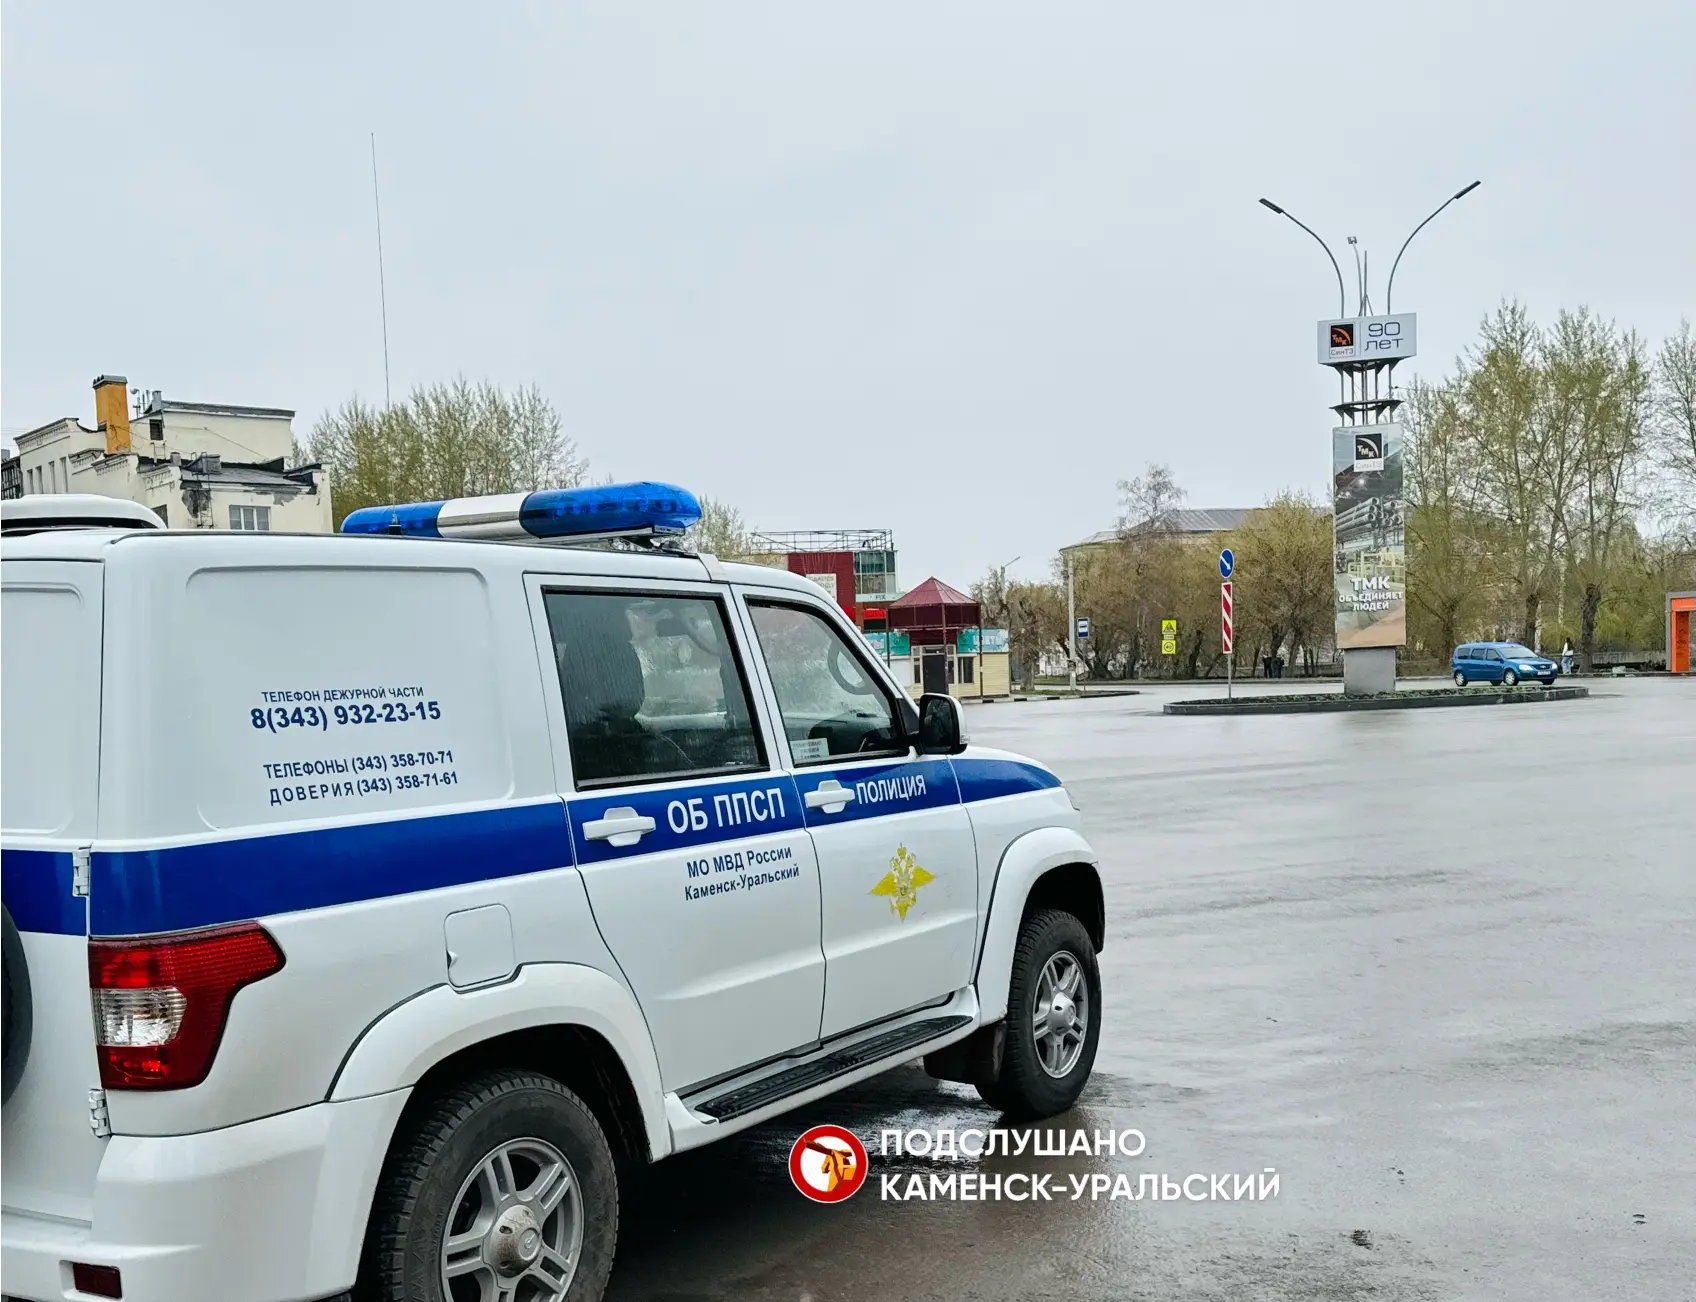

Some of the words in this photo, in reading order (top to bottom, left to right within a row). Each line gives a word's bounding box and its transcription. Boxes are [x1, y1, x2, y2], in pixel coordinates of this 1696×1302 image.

[1368, 322, 1400, 337] 90
[1332, 334, 1347, 345] ТМК
[1365, 338, 1404, 351] лет
[1331, 348, 1353, 356] СинТЗ
[1357, 445, 1375, 458] ТМК
[1351, 576, 1390, 591] ТМК
[1338, 591, 1404, 603] ОБЪЕДИНЯЕТ
[1352, 601, 1389, 611] ЛЮДЕЙ
[261, 690, 321, 703] ТЕЛЕФОН
[323, 686, 386, 702] ДЕЖУРНОЙ
[388, 686, 424, 698] ЧАСТИ
[250, 706, 328, 733] 8(343)
[334, 701, 441, 725] 932-23-15
[263, 758, 349, 779] ТЕЛЕФОНЫ
[352, 755, 387, 774] (343)
[390, 750, 454, 768] 358-70-71
[269, 781, 354, 806] ДОВЕРИЯ
[357, 777, 392, 796] (343)
[395, 771, 458, 790] 358-71-61
[856, 775, 927, 805] ПОЛИЦИЯ
[667, 797, 709, 834] ОБ
[714, 787, 786, 828] ППСП
[687, 859, 710, 879] МО
[713, 852, 744, 874] МВД
[747, 846, 792, 867] России
[685, 863, 800, 901] Каменск-Уральский
